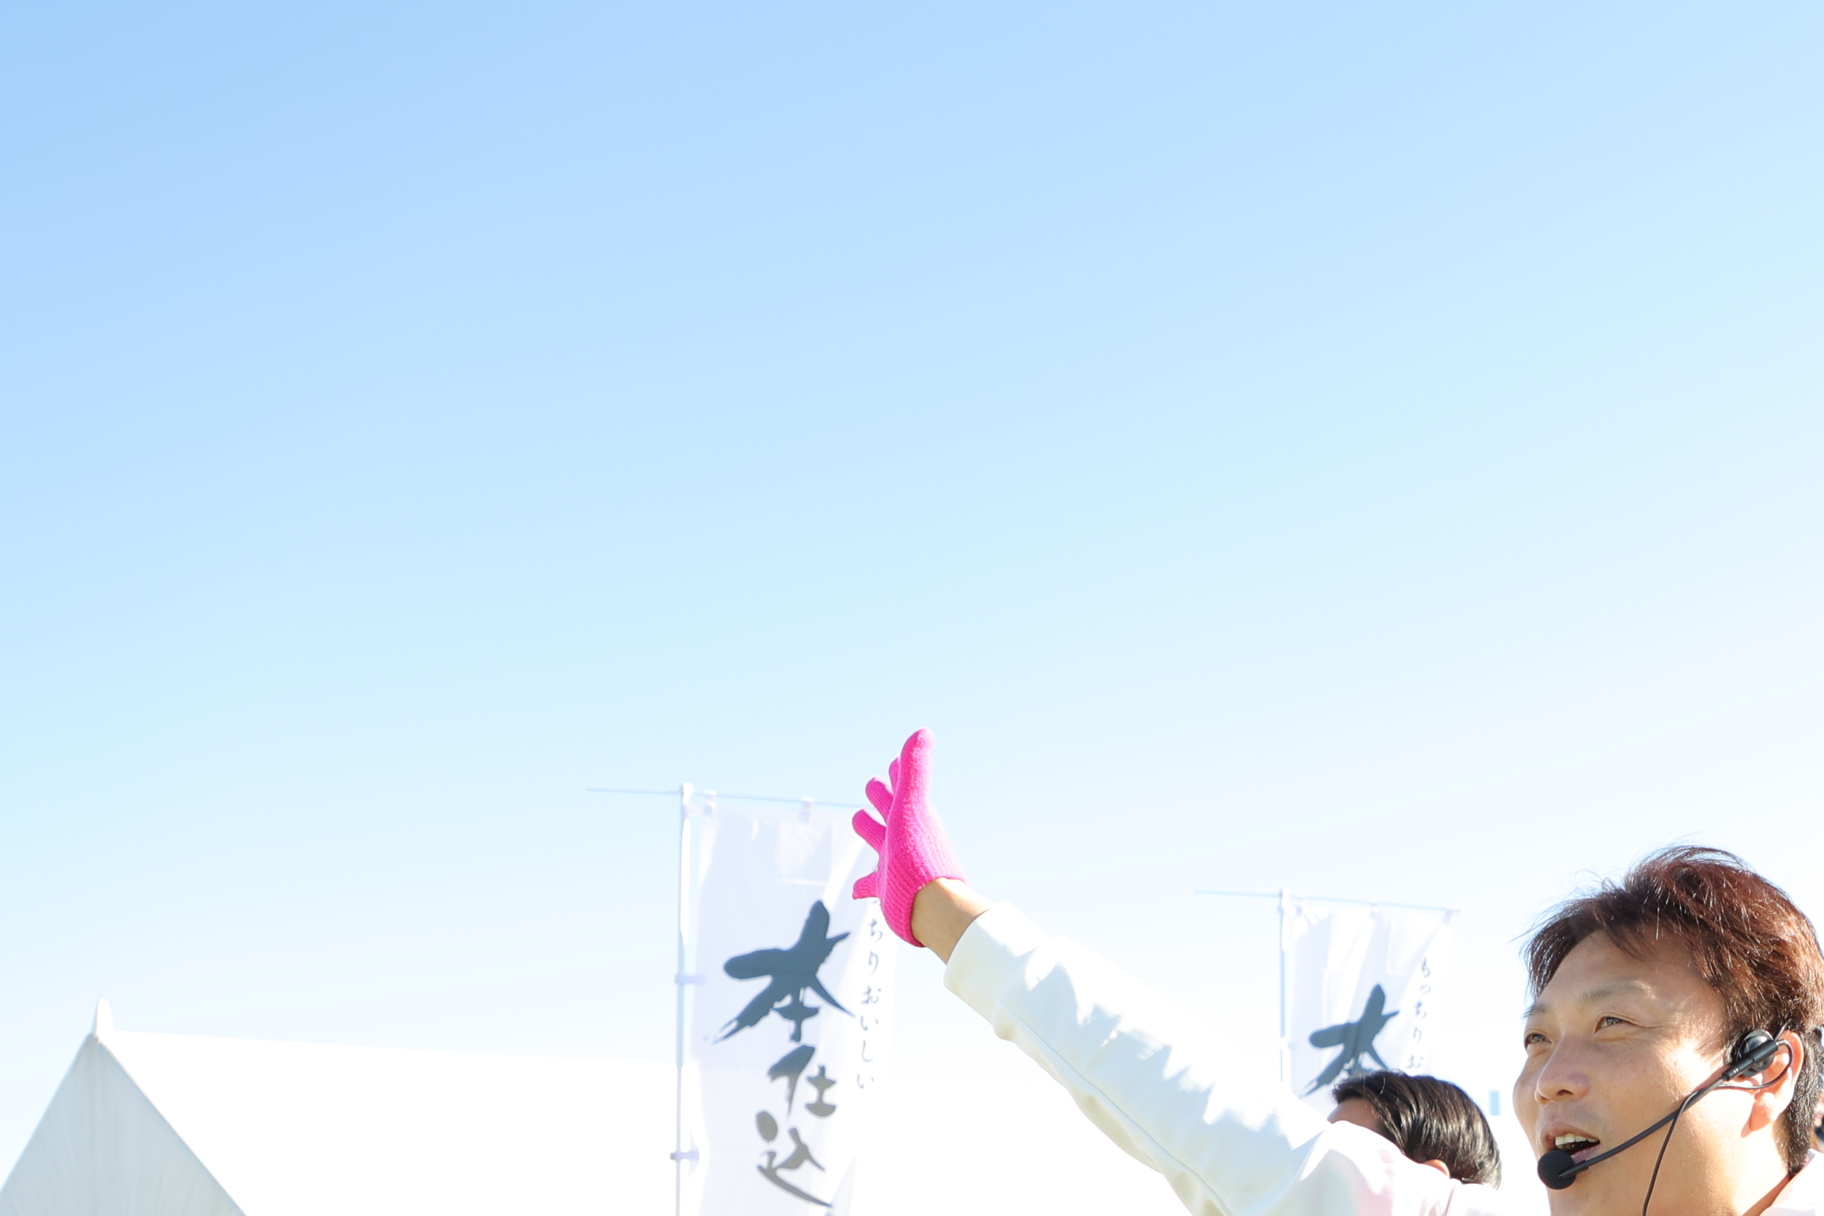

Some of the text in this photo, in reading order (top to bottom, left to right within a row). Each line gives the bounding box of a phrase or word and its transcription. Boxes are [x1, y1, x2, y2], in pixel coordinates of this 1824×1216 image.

[706, 899, 856, 1208] 本仕込
[856, 915, 885, 1090] ちりおいしい
